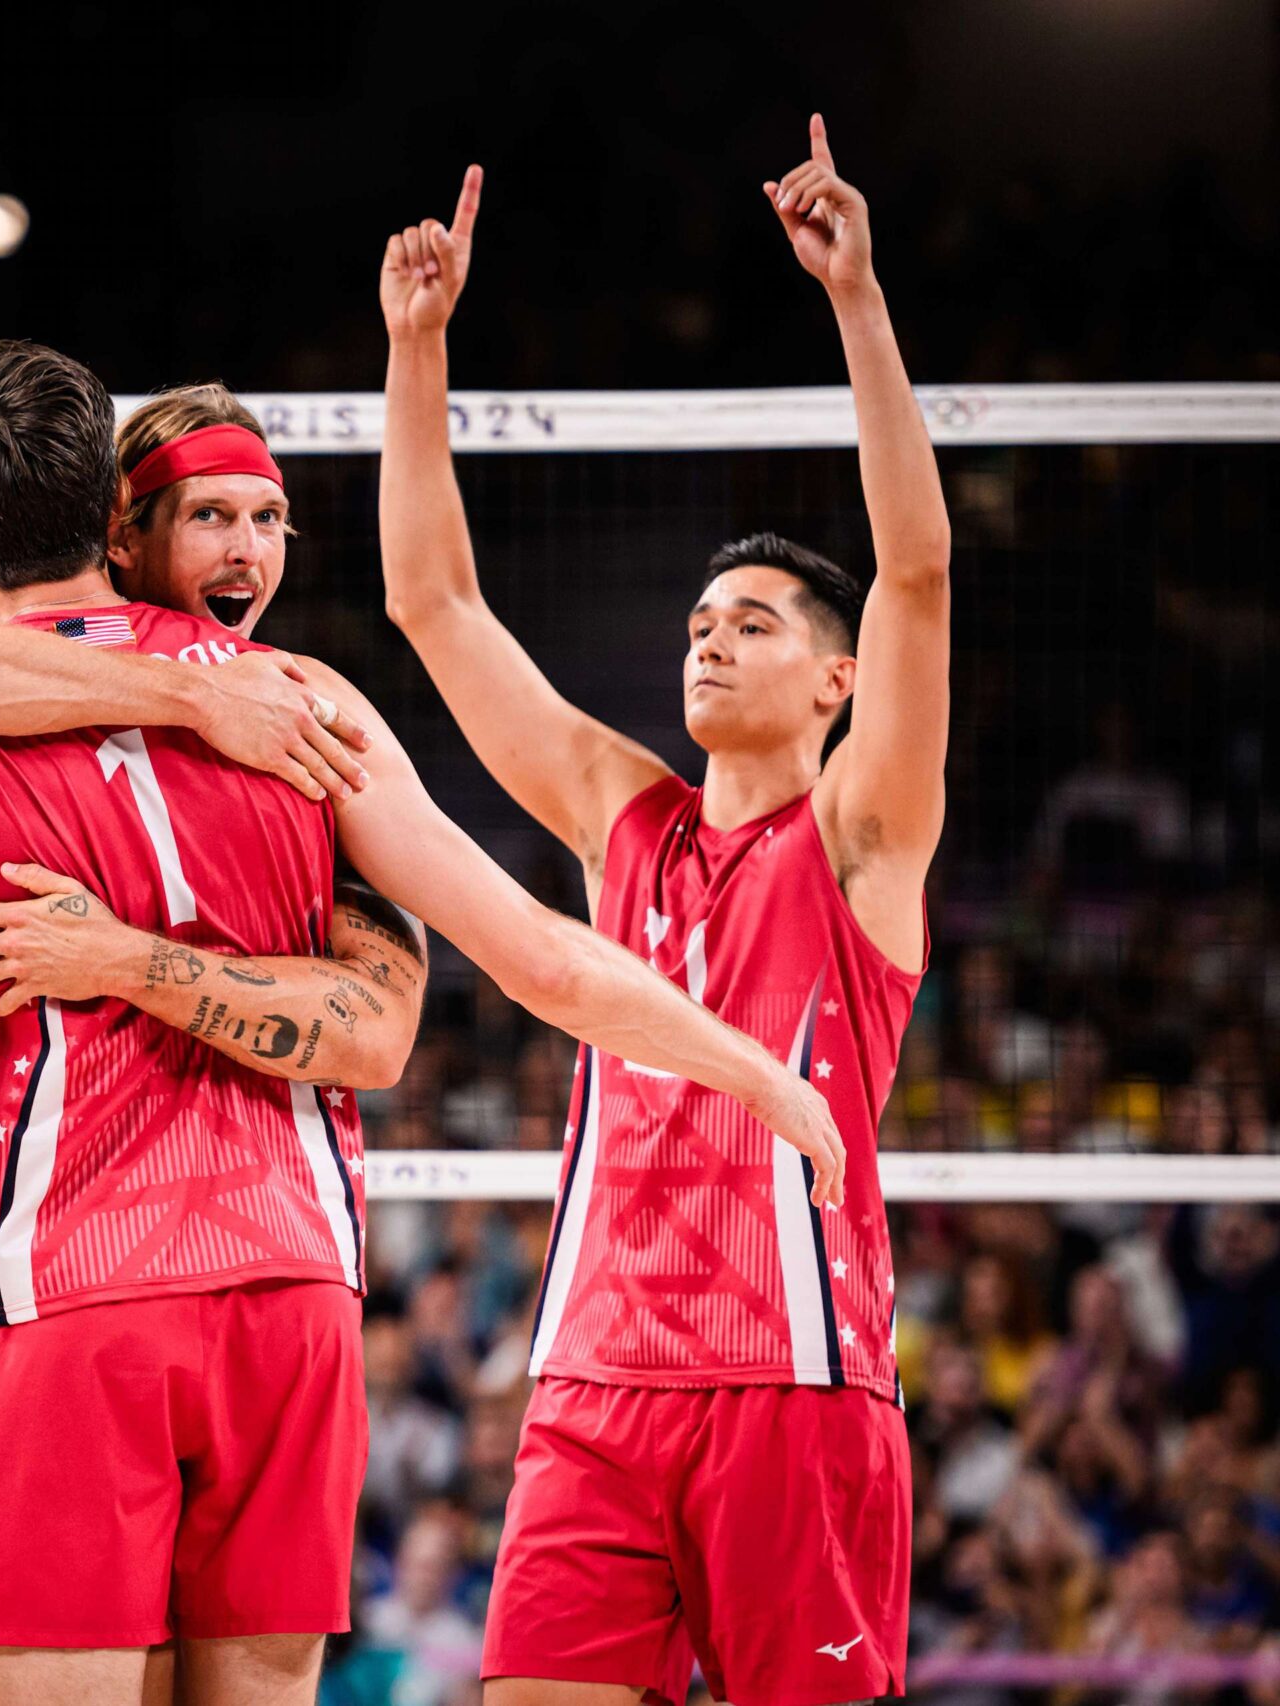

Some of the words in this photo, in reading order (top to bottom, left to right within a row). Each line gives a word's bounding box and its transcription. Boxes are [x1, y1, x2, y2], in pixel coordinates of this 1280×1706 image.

[264, 404, 359, 438] RIS
[448, 405, 554, 439] 024
[95, 728, 197, 927] 1
[145, 939, 159, 989] FORGET
[296, 1019, 322, 1069] NOTHING
